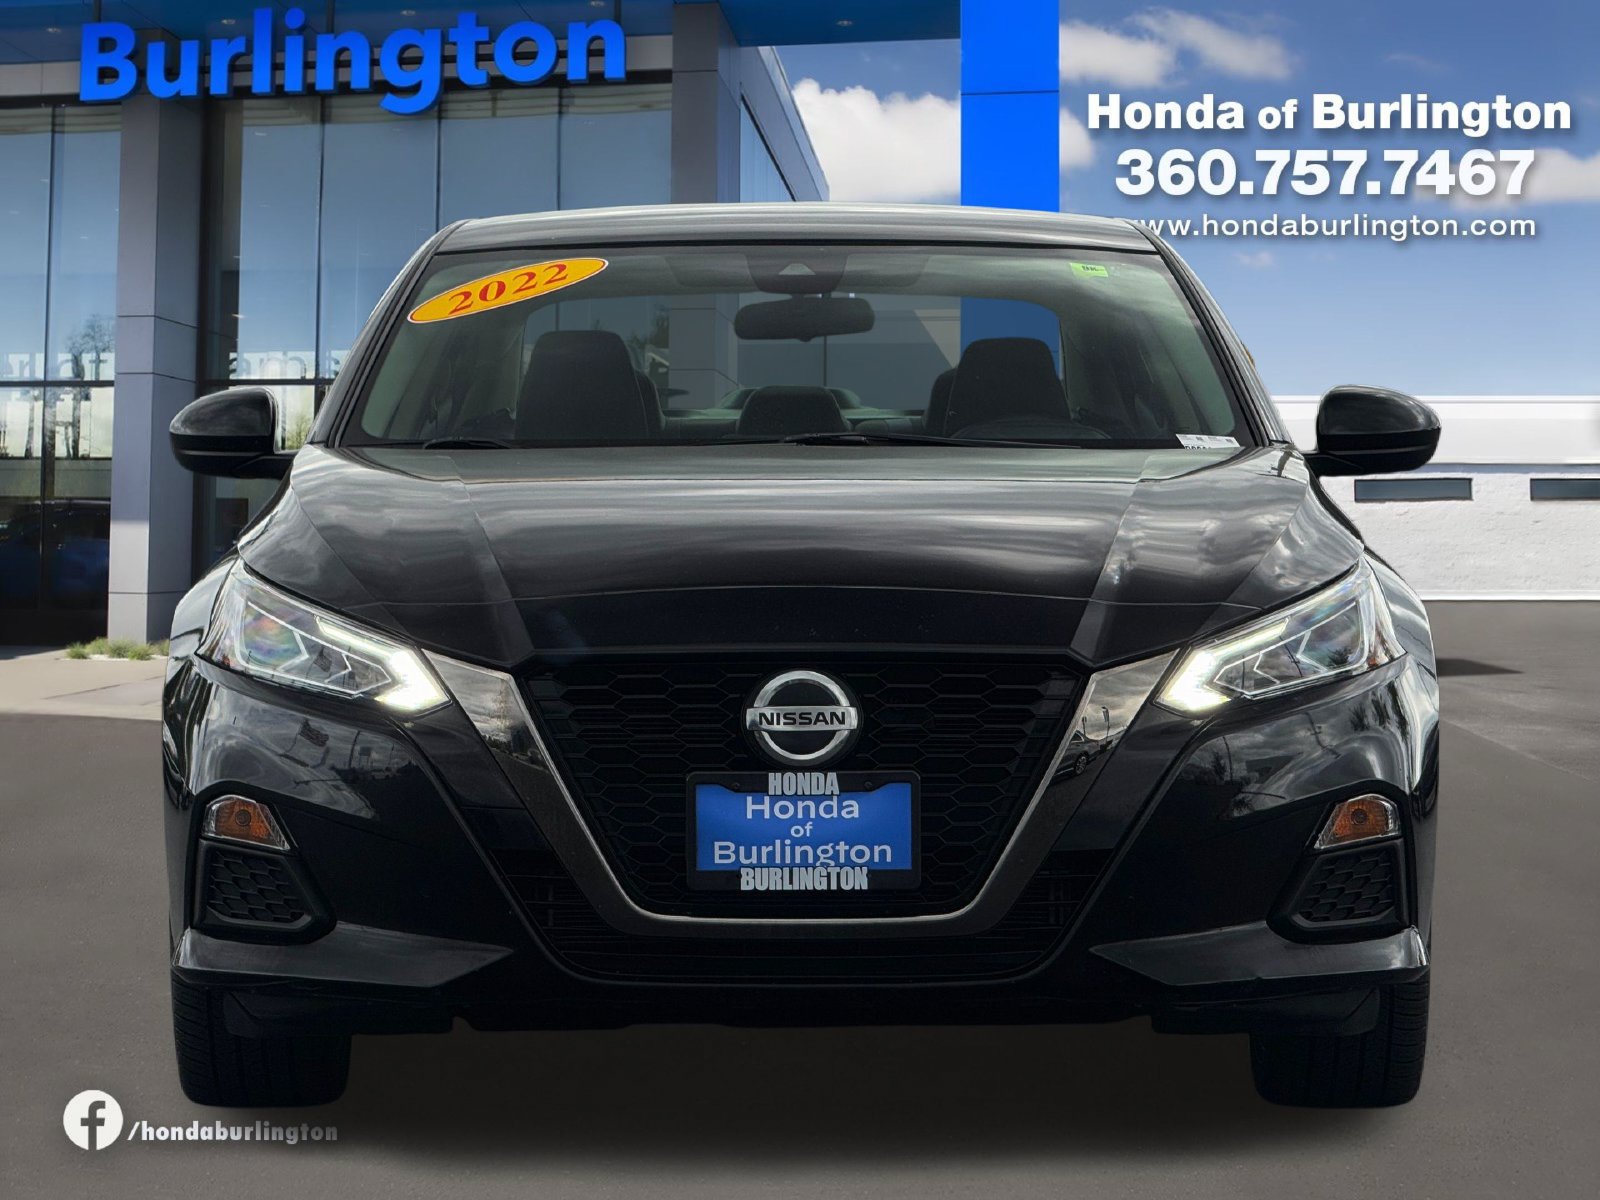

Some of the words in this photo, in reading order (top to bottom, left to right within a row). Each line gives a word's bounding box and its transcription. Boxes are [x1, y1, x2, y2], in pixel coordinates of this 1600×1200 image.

[79, 7, 626, 115] Burlington
[448, 263, 569, 315] 2022
[758, 711, 846, 726] NISSAN
[768, 771, 840, 796] HONDA
[746, 795, 860, 819] Honda
[790, 822, 813, 838] of
[713, 839, 893, 867] Burlington
[740, 866, 868, 891] BURLINGTON
